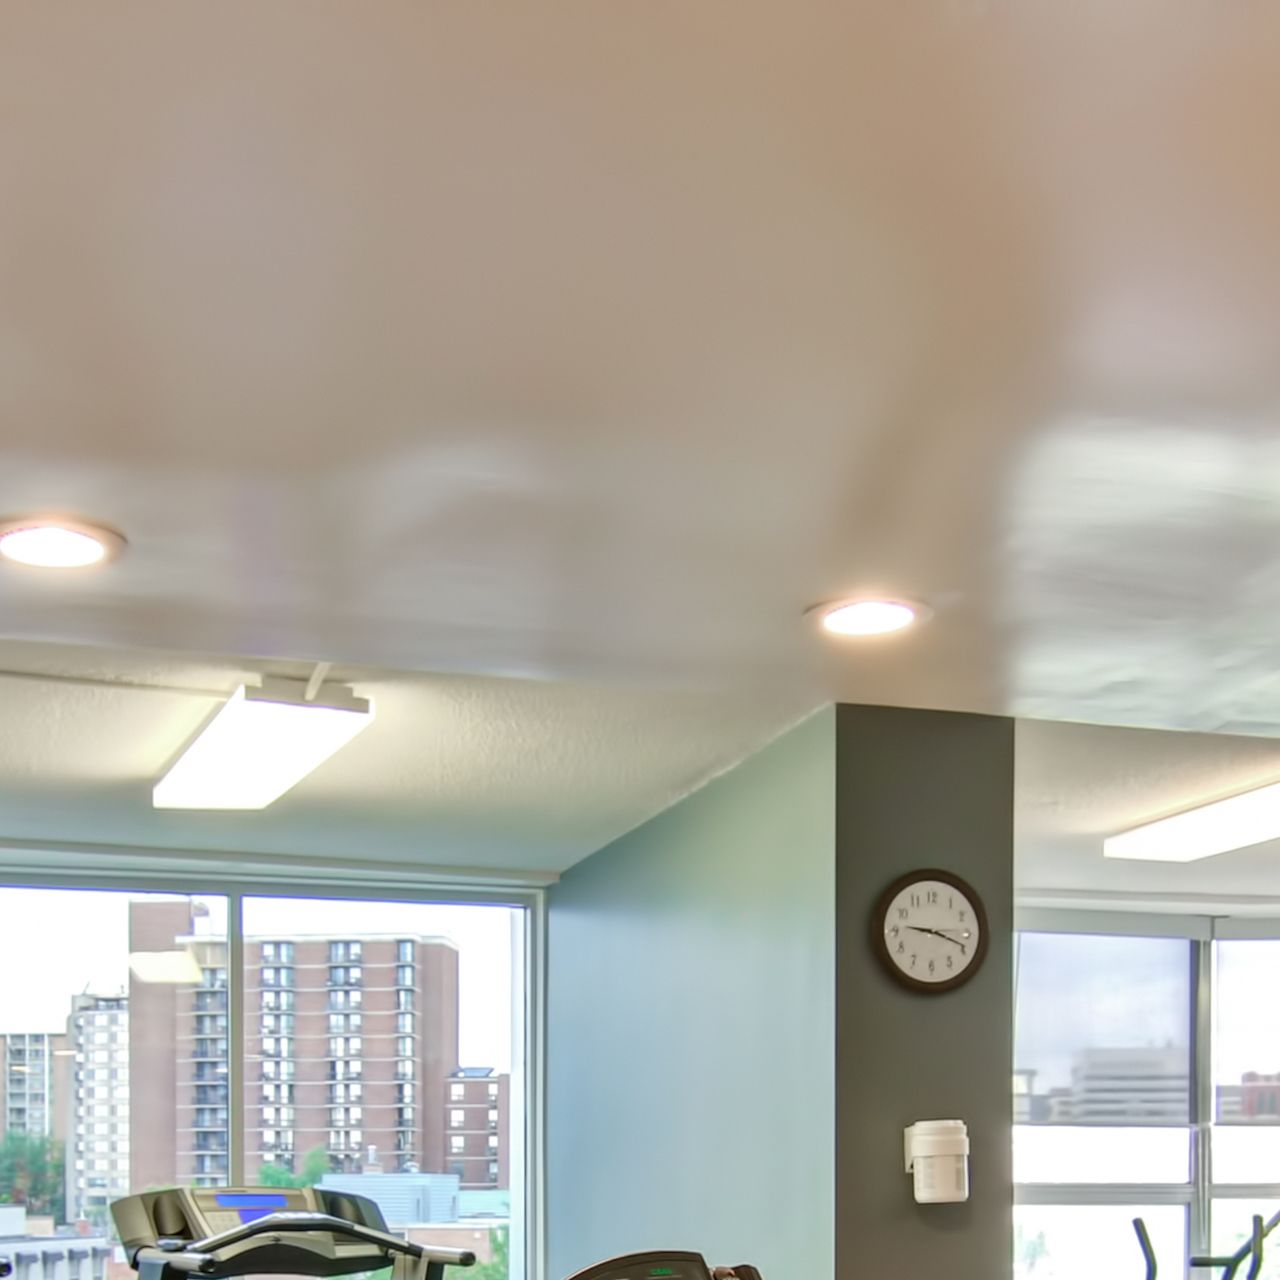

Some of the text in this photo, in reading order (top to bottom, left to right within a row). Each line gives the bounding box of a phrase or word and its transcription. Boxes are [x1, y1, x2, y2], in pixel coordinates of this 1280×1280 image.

[910, 893, 920, 908] 11
[927, 891, 938, 904] 12
[948, 896, 953, 909] 1
[898, 908, 909, 920] 10
